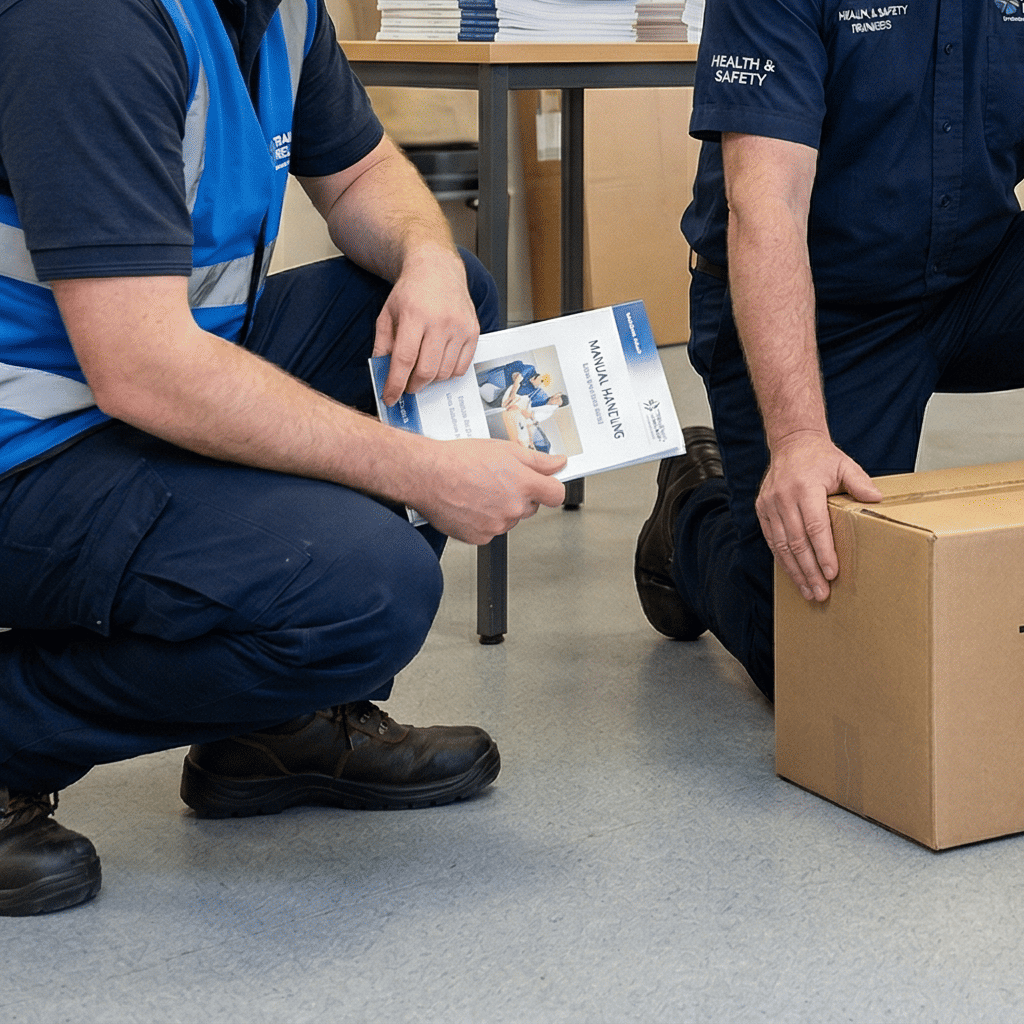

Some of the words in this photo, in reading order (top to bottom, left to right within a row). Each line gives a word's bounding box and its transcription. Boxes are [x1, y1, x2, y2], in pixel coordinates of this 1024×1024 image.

[711, 54, 760, 71] HEALTH
[763, 59, 775, 73] &
[714, 69, 767, 87] SAFETY
[588, 339, 609, 386] MANUAL
